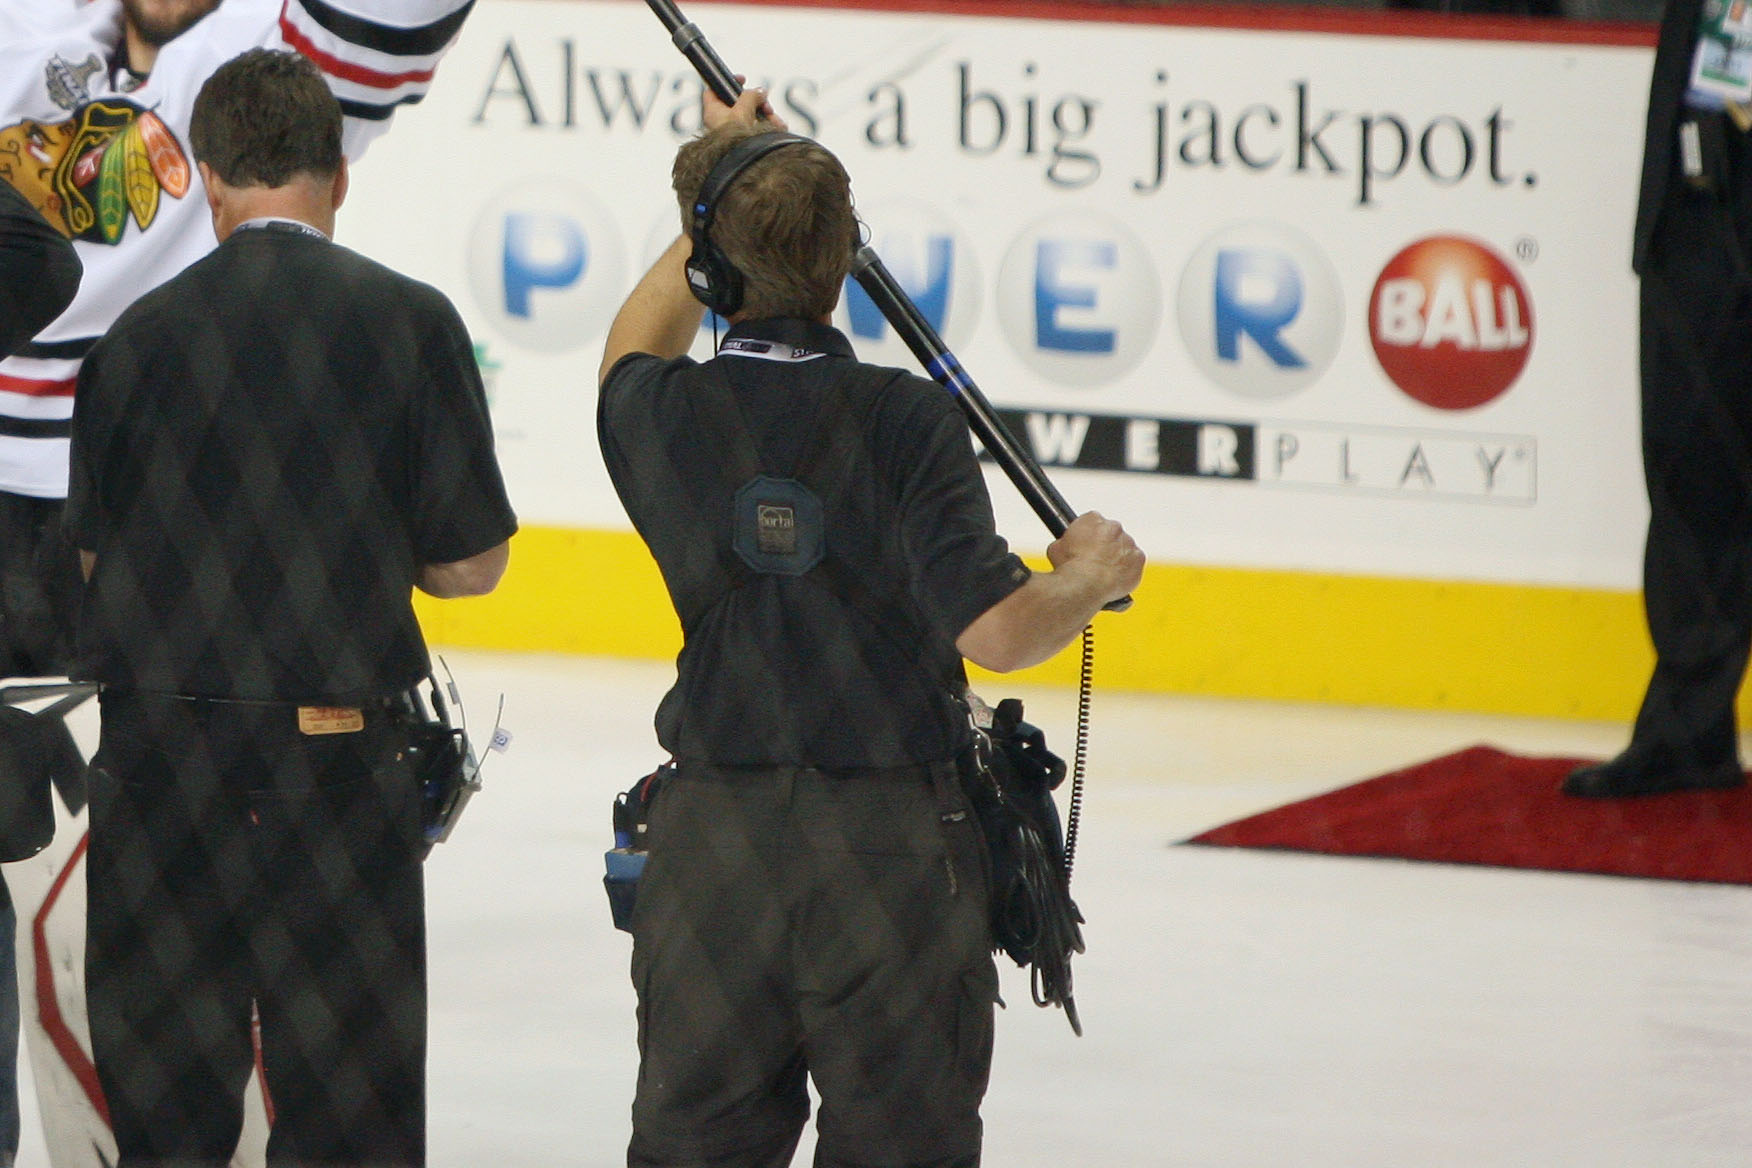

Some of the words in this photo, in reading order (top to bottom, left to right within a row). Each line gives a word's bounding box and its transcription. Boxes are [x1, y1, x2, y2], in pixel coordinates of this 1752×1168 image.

[472, 36, 820, 132] Alwas
[865, 81, 911, 150] a
[958, 60, 1101, 189] big
[1133, 68, 1538, 206] jackpot.
[502, 211, 1311, 372] PWER
[1378, 268, 1529, 352] BALL
[1275, 431, 1508, 493] PLAY
